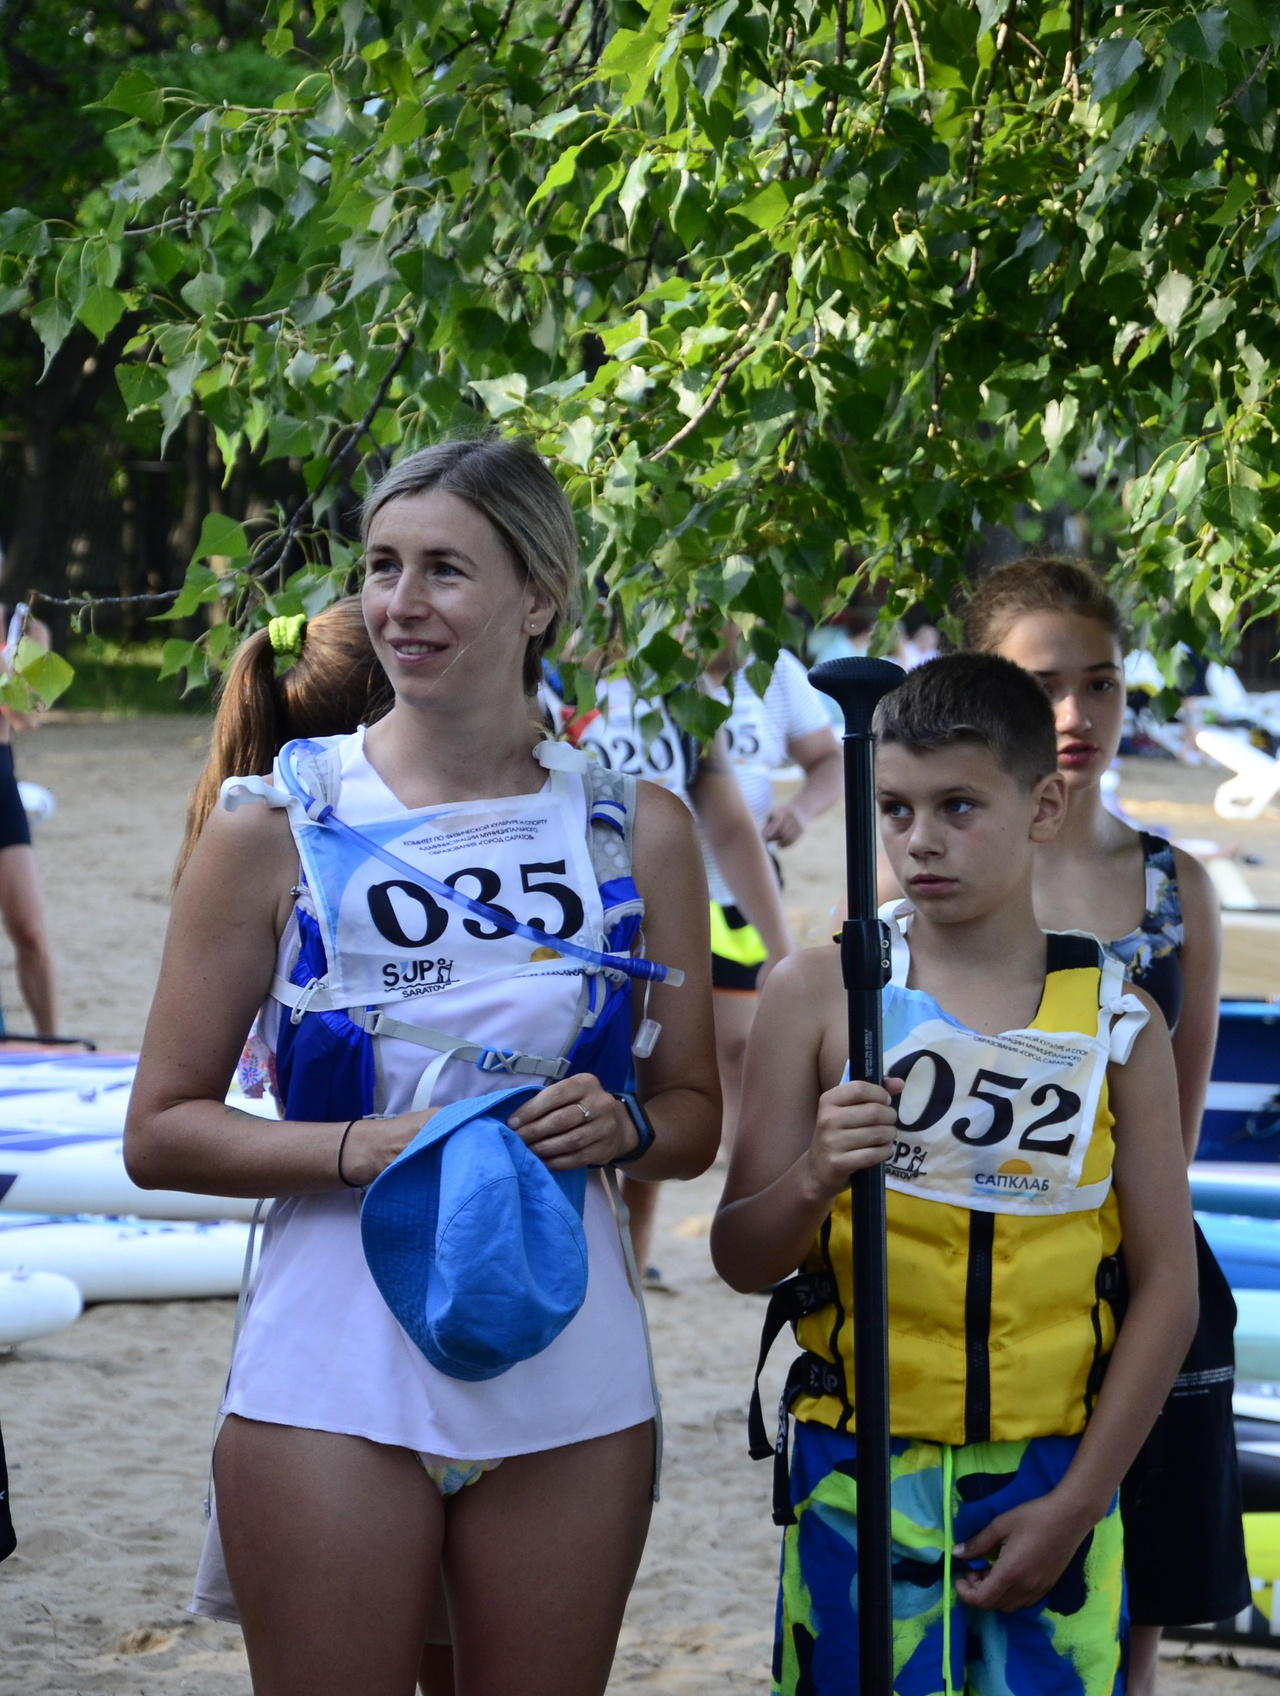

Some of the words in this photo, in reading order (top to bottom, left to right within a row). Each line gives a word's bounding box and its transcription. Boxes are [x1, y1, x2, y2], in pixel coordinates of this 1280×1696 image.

[366, 859, 585, 948] 035
[382, 959, 435, 988] SUP
[402, 984, 446, 999] SARATOV
[886, 1049, 1081, 1157] 052
[974, 1173, 1050, 1192] САПКЛАБ
